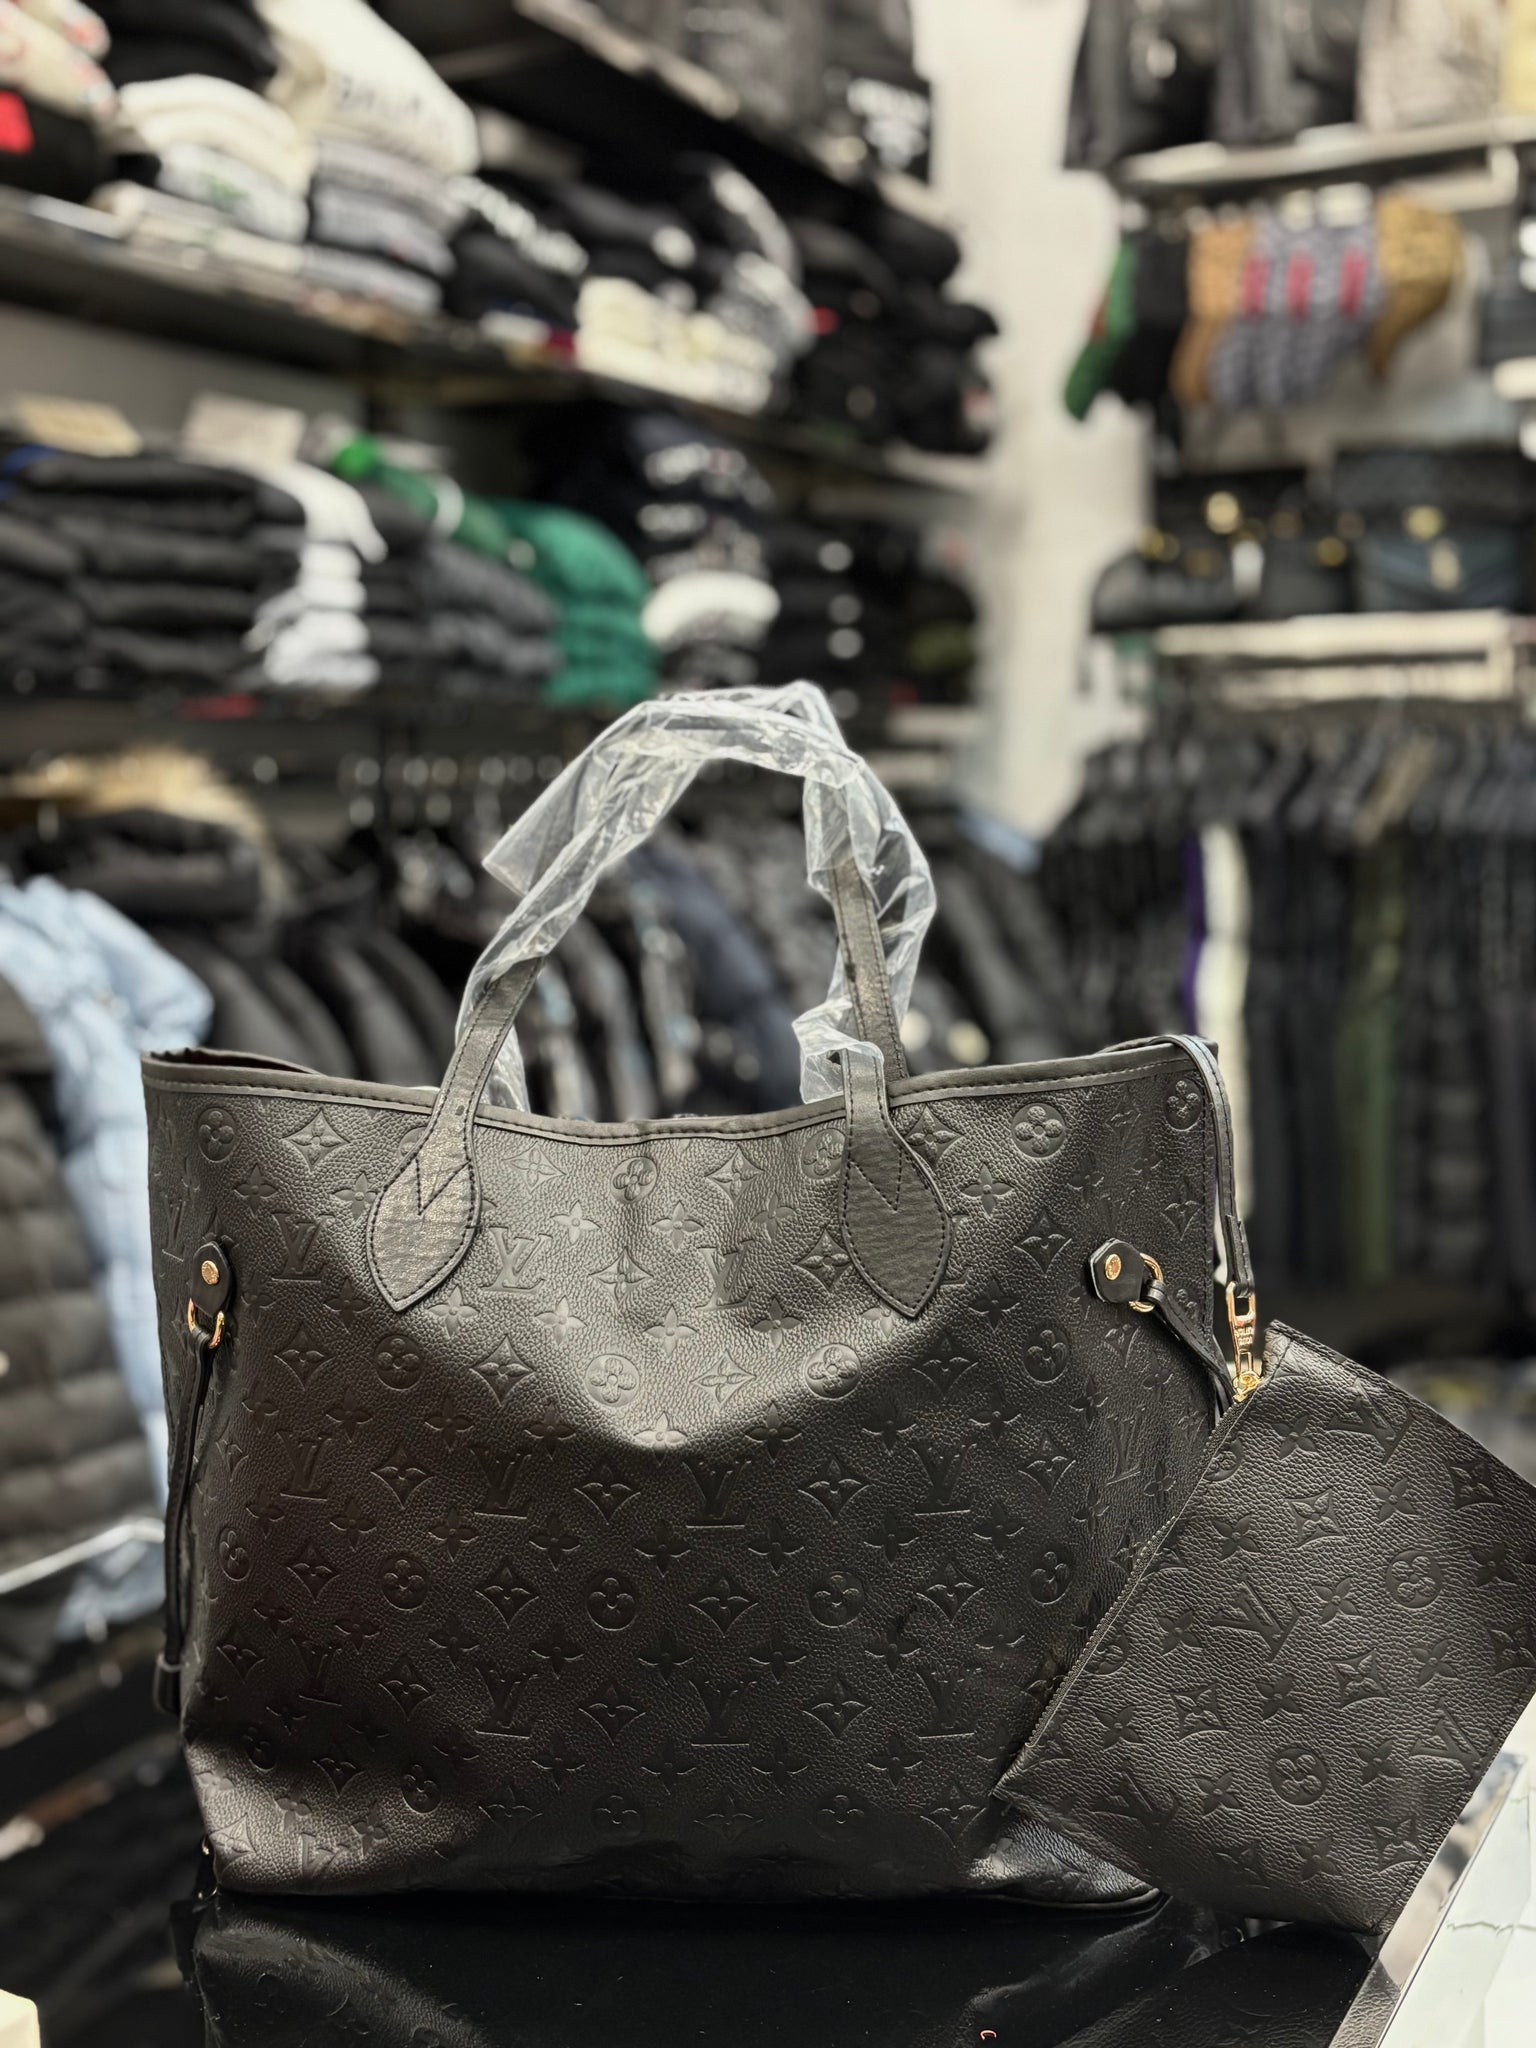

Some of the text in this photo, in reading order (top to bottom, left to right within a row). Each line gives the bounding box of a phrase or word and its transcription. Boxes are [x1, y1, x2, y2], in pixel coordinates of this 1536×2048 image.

[270, 1210, 336, 1283] LV
[482, 1226, 552, 1294] LV
[698, 1238, 756, 1311] LV
